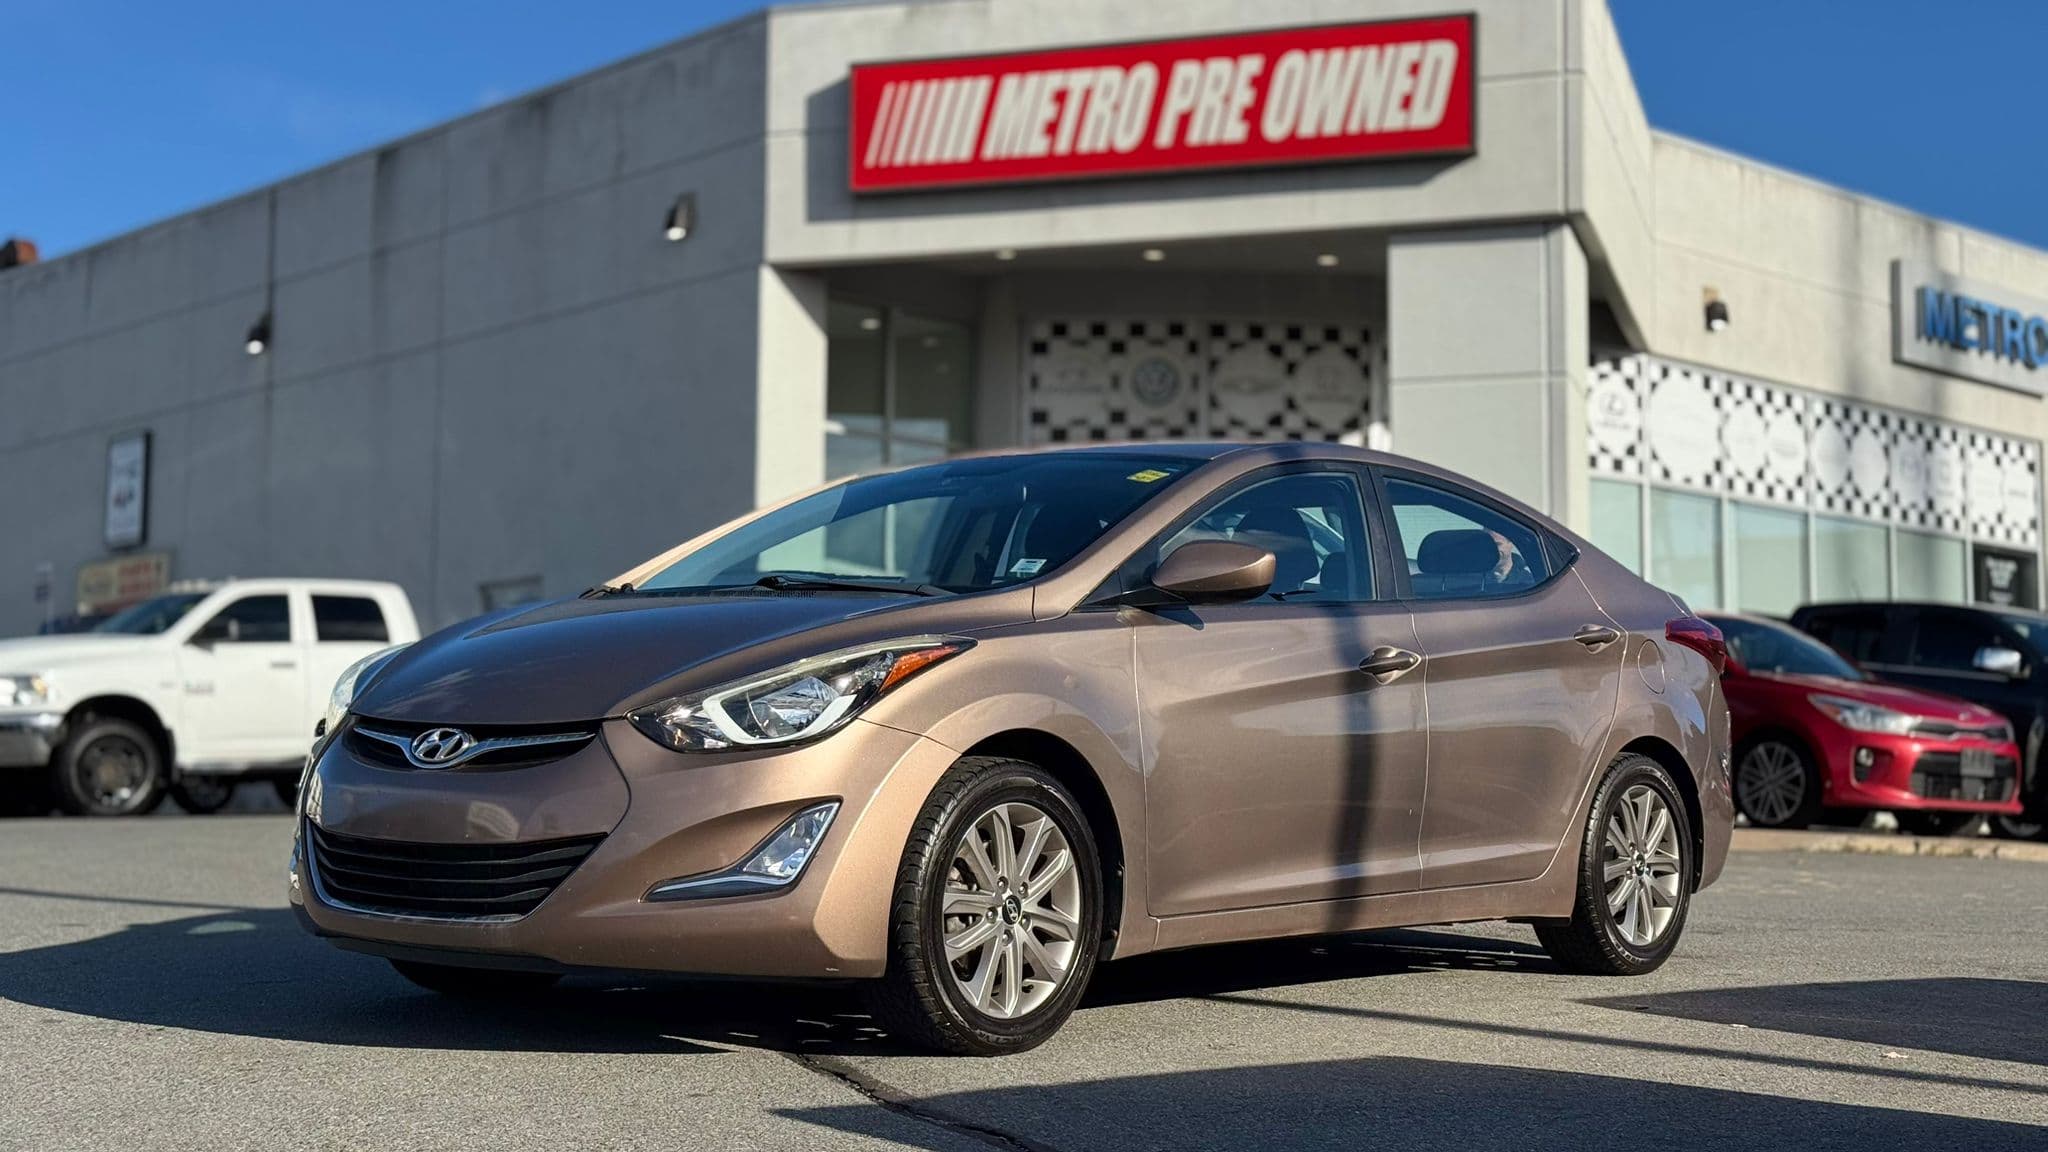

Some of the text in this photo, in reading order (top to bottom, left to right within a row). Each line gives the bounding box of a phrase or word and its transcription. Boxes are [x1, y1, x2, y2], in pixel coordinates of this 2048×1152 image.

[982, 39, 1458, 159] METRO PRE OWNED
